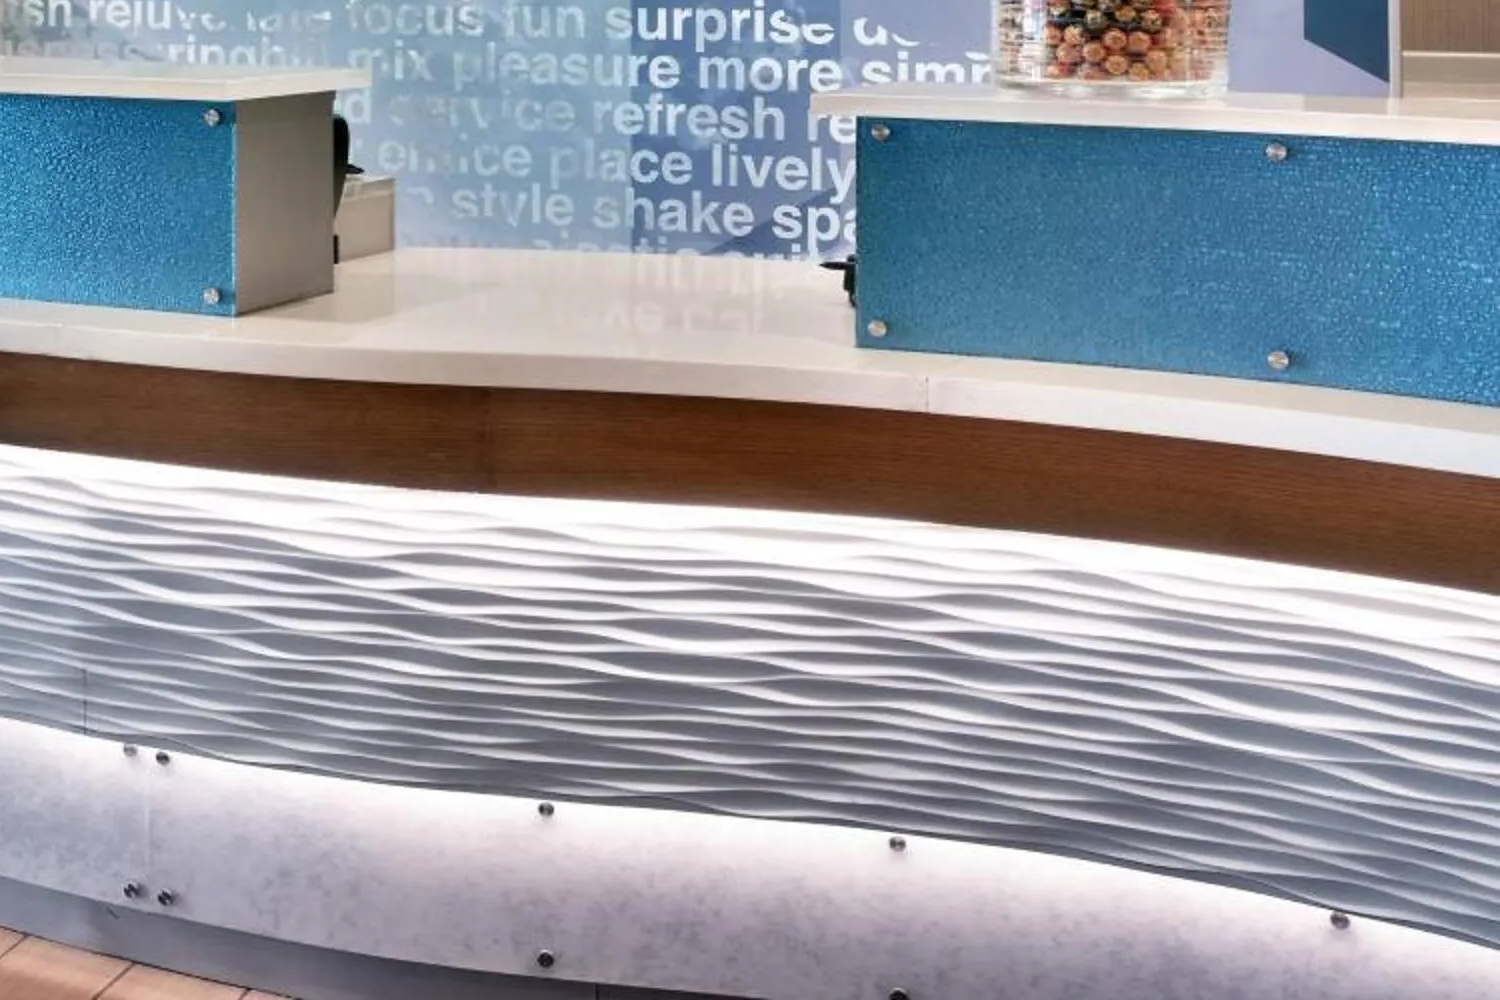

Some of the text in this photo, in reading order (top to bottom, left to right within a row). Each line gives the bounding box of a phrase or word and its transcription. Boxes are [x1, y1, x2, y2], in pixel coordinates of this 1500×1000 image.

[454, 41, 681, 92] pleasure
[700, 54, 844, 93] more
[593, 93, 786, 142] refresh
[550, 137, 694, 190] place
[711, 143, 857, 205] lively
[450, 183, 576, 228] style
[591, 187, 756, 238] shake
